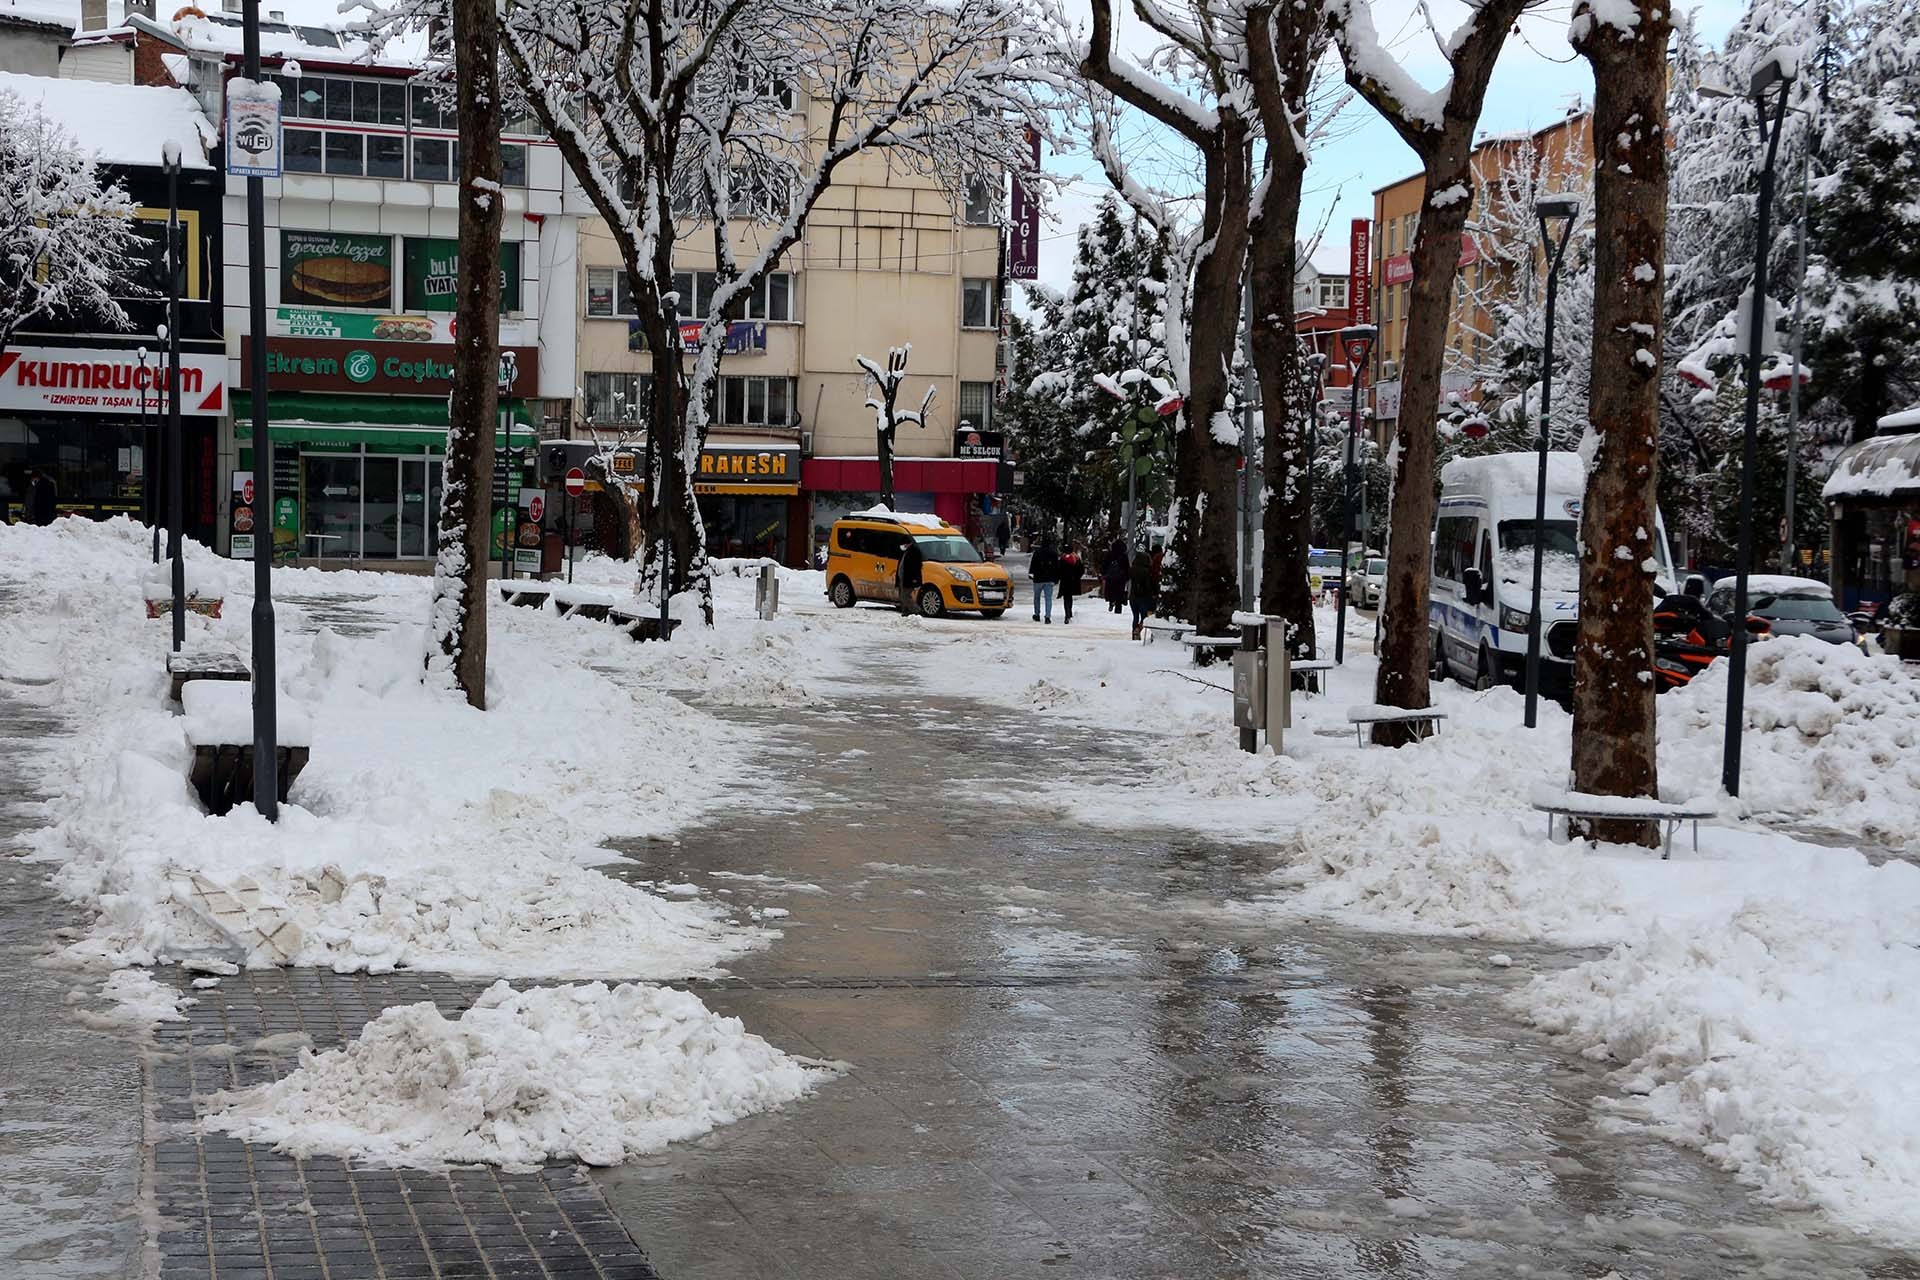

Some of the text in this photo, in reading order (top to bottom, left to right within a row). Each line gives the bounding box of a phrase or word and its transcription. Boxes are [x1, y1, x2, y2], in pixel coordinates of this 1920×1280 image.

[288, 239, 340, 258] gerçek
[1355, 231, 1366, 277] Merkezi
[1012, 261, 1037, 276] kurs
[1354, 280, 1365, 305] Kurs
[383, 357, 454, 383] Coşku
[102, 396, 132, 408] TAŞAN
[701, 454, 786, 474] RAKESH
